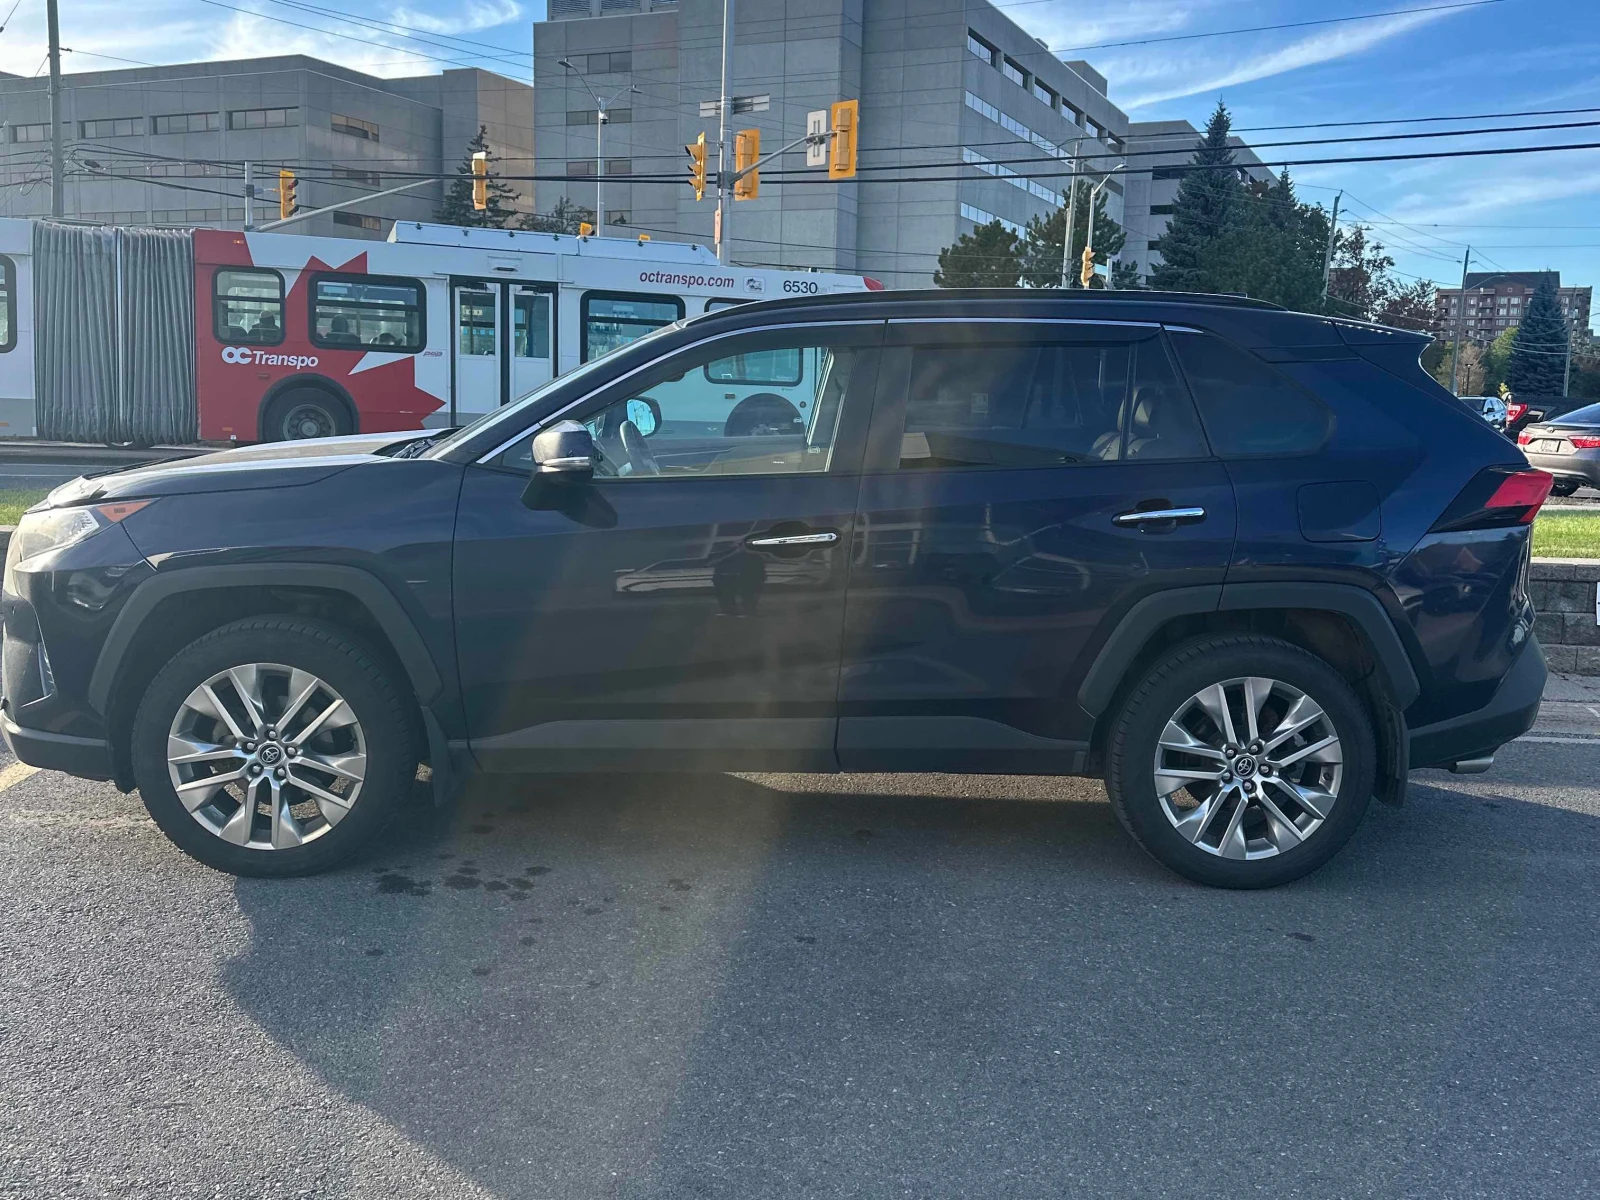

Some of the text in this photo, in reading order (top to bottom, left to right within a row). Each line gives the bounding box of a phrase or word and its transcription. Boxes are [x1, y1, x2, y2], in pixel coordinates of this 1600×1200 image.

[639, 271, 735, 288] octranspo.com
[783, 280, 818, 294] 6530
[221, 346, 319, 370] OC Transpo
